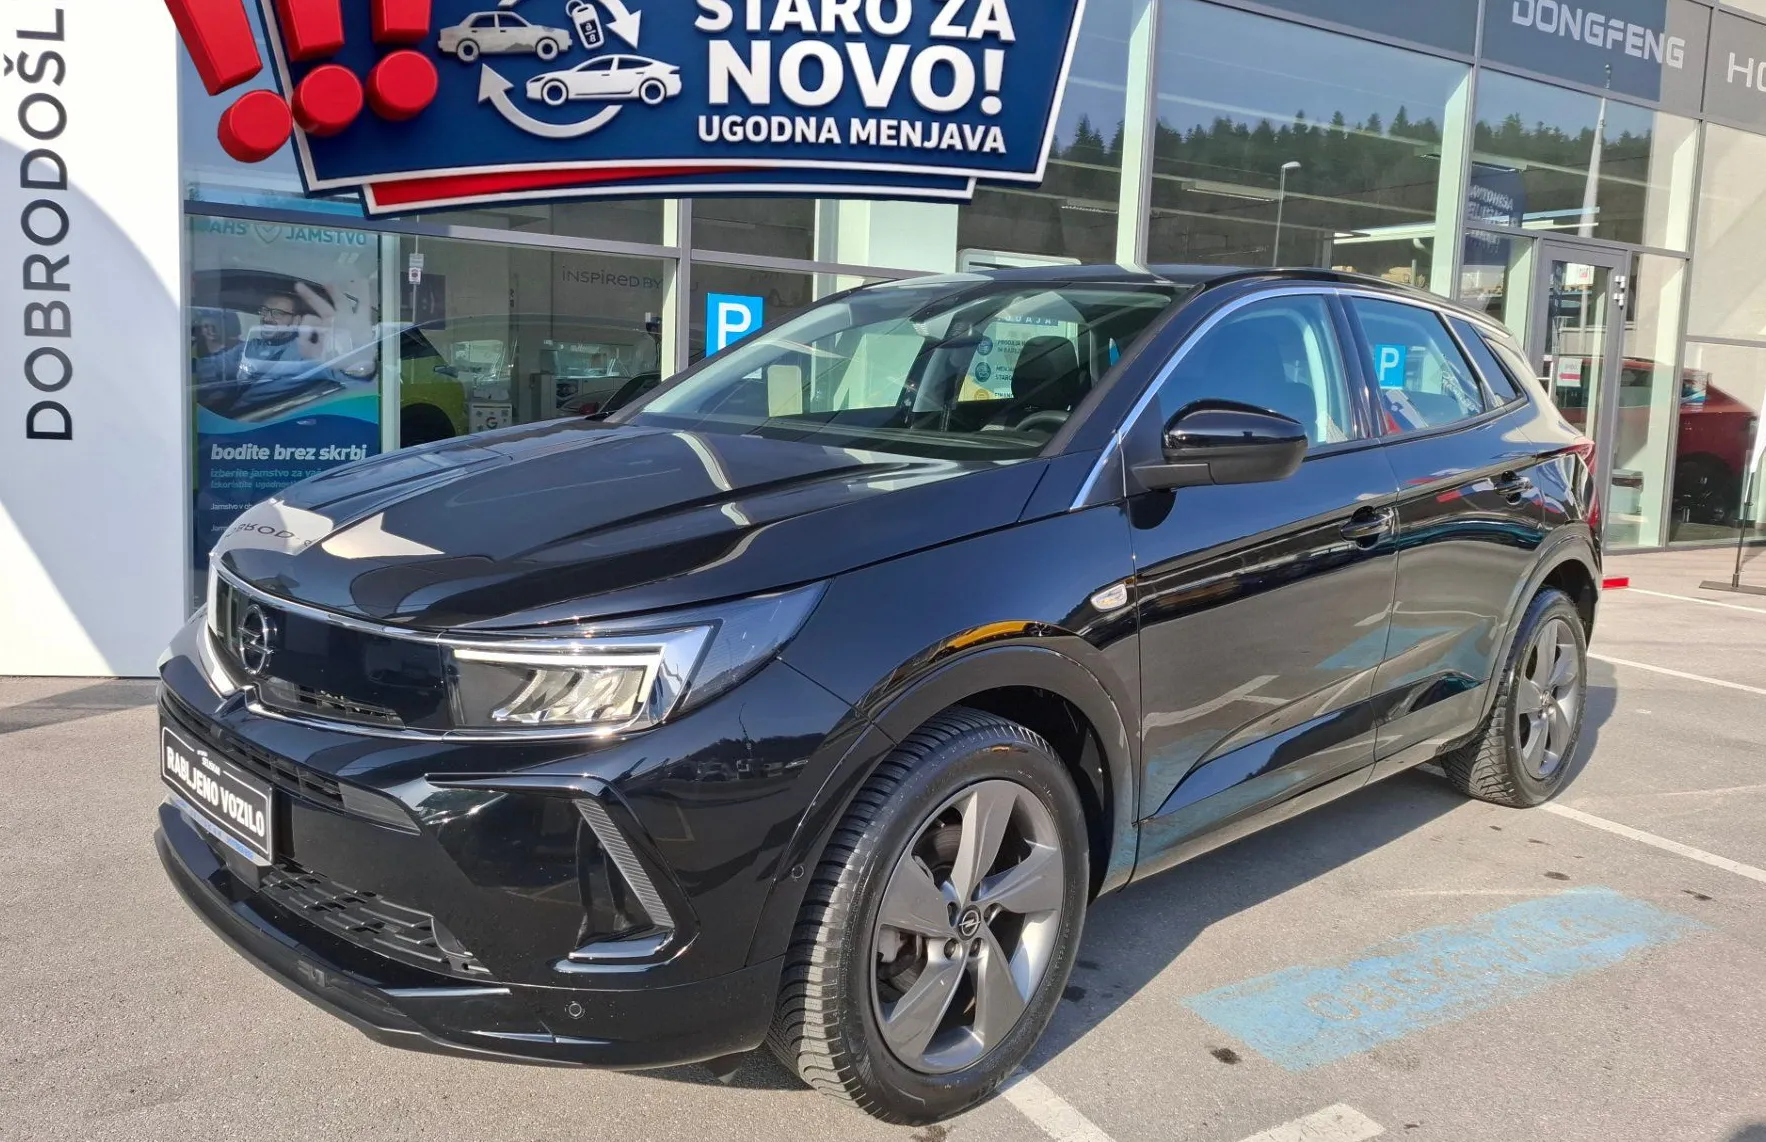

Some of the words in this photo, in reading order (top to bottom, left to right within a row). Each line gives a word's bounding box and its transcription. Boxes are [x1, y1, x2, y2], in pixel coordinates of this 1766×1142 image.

[1512, 0, 1686, 69] DONGFENG
[210, 218, 248, 236] AHS
[285, 224, 367, 246] JAMSTVO
[718, 302, 752, 351] P
[1380, 347, 1400, 381] P
[211, 443, 270, 460] bodite
[274, 444, 316, 460] brez
[318, 444, 367, 462] skrbi
[249, 468, 289, 479] jamstvo
[166, 745, 219, 806] RABLJENO
[219, 786, 265, 837] VOZILO
